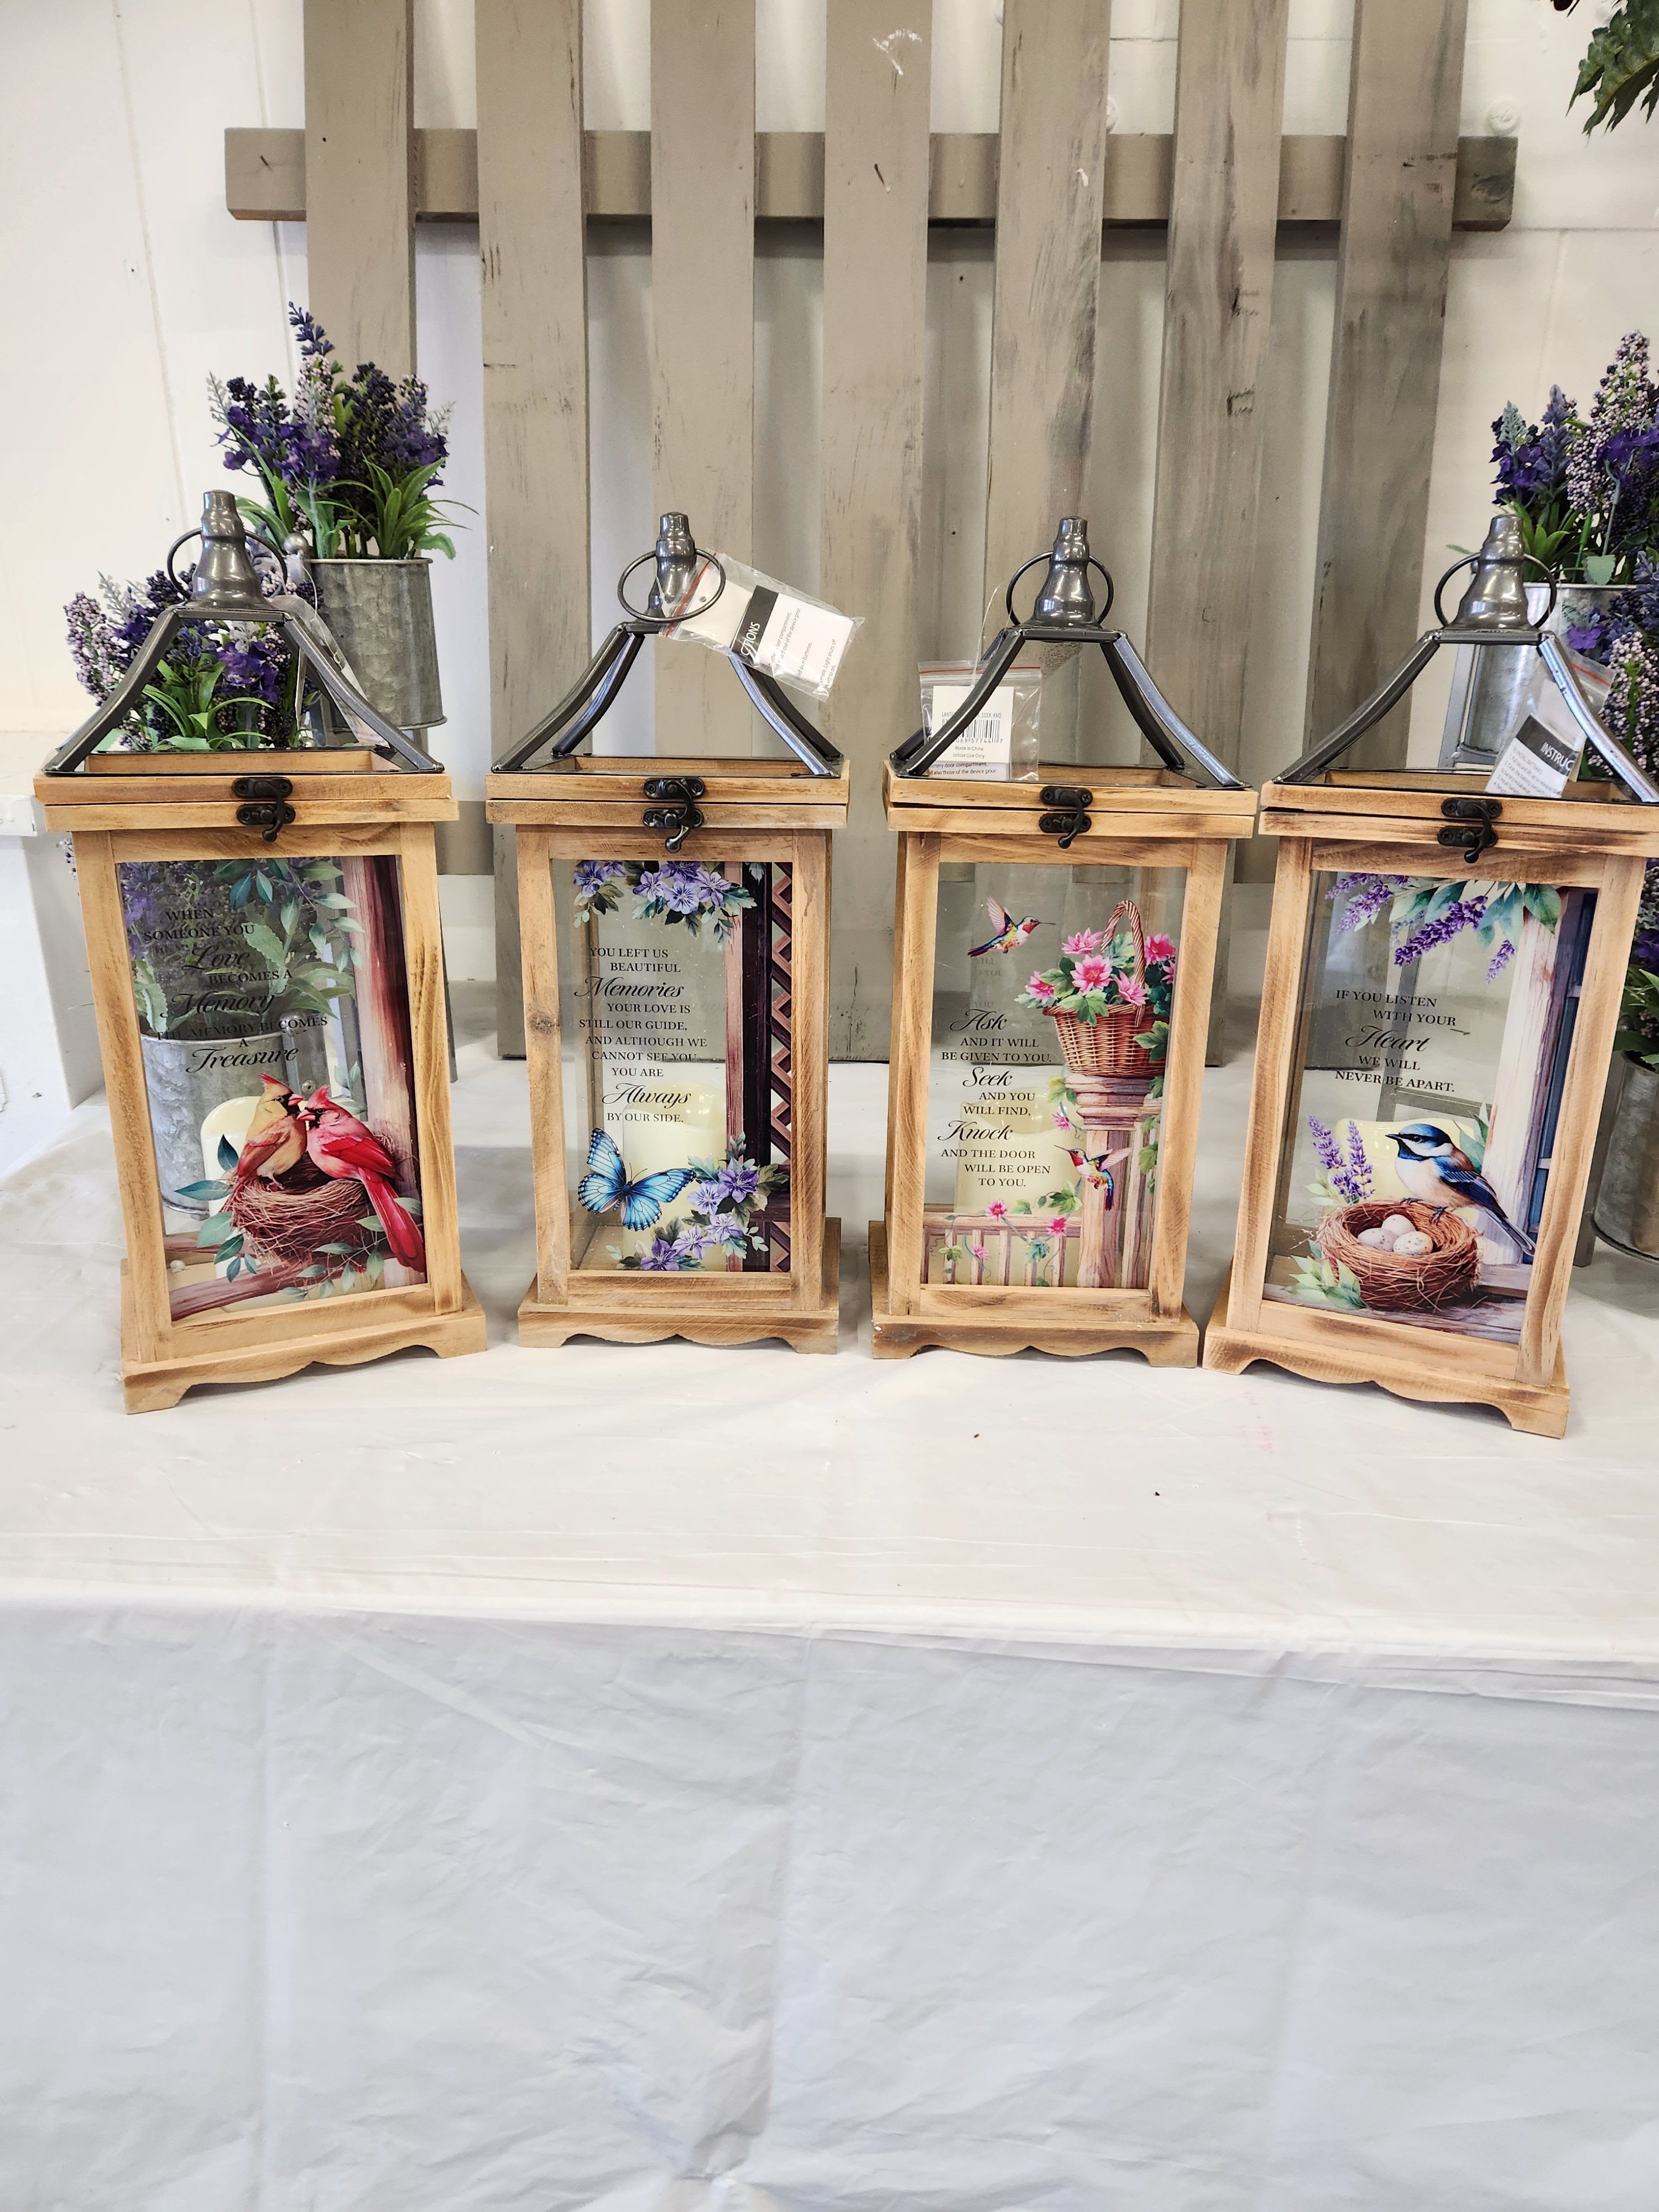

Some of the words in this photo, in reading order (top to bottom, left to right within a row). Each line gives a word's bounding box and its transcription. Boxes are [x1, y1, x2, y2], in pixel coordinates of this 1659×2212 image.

[166, 909, 214, 921] WHEN
[144, 927, 221, 941] SOMEONE
[222, 925, 254, 936] YOU
[181, 945, 250, 971] Love
[589, 947, 615, 957] YOU
[619, 948, 649, 958] LEFT
[653, 949, 669, 958] US
[610, 962, 681, 973] BEAUTIFUL
[208, 971, 279, 985] BECOMES
[283, 969, 293, 979] A
[574, 976, 685, 998] Memories
[160, 991, 275, 1019] Memory
[1336, 990, 1350, 999] IF
[1353, 991, 1382, 1003] YOU
[1384, 994, 1437, 1008] LISTEN
[607, 1003, 641, 1013] YOUR
[644, 1004, 676, 1013] LOVE
[680, 1005, 691, 1014] IS
[950, 1009, 1008, 1032] Ask
[1373, 1009, 1412, 1022] WITH
[1416, 1014, 1456, 1026] YOUR
[579, 1019, 613, 1029] STILL
[616, 1020, 642, 1029] OUR
[645, 1021, 687, 1031] GUIDE,
[239, 1038, 248, 1048] A
[585, 1036, 612, 1045] AND
[615, 1037, 684, 1047] ALTHOUGH
[687, 1038, 707, 1047] WE
[961, 1037, 988, 1047] AND
[991, 1038, 1004, 1047] IT
[1007, 1039, 1039, 1047] WILL
[1345, 1025, 1432, 1052] Heart
[186, 1047, 299, 1073] Treasure
[592, 1051, 644, 1061] CANNOT
[646, 1052, 668, 1061] SEE
[942, 1052, 957, 1061] BE
[960, 1052, 999, 1061] GIVEN
[1003, 1053, 1020, 1062] TO
[1358, 1055, 1381, 1066] WE
[1384, 1058, 1421, 1070] WILL
[611, 1067, 637, 1076] YOU
[640, 1068, 664, 1077] ARE
[963, 1066, 1013, 1087] Seek
[1335, 1071, 1381, 1084] NEVER
[1385, 1076, 1403, 1086] BE
[1406, 1078, 1455, 1092] APART.
[602, 1083, 691, 1109] Always
[978, 1092, 1005, 1100] AND
[1009, 1093, 1035, 1101] YOU
[963, 1106, 995, 1115] WILL
[998, 1107, 1031, 1117] FIND,
[607, 1113, 623, 1121] BY
[625, 1113, 650, 1121] OUR
[654, 1114, 684, 1123] SIDE.
[937, 1120, 1013, 1141] Knock
[941, 1149, 968, 1157] AND
[971, 1150, 996, 1158] THE
[999, 1150, 1036, 1159] DOOR
[964, 1164, 995, 1172] WILL
[999, 1165, 1014, 1173] BE
[1017, 1165, 1051, 1174] OPEN
[978, 1178, 995, 1186] TO
[998, 1178, 1026, 1187] YOU.
